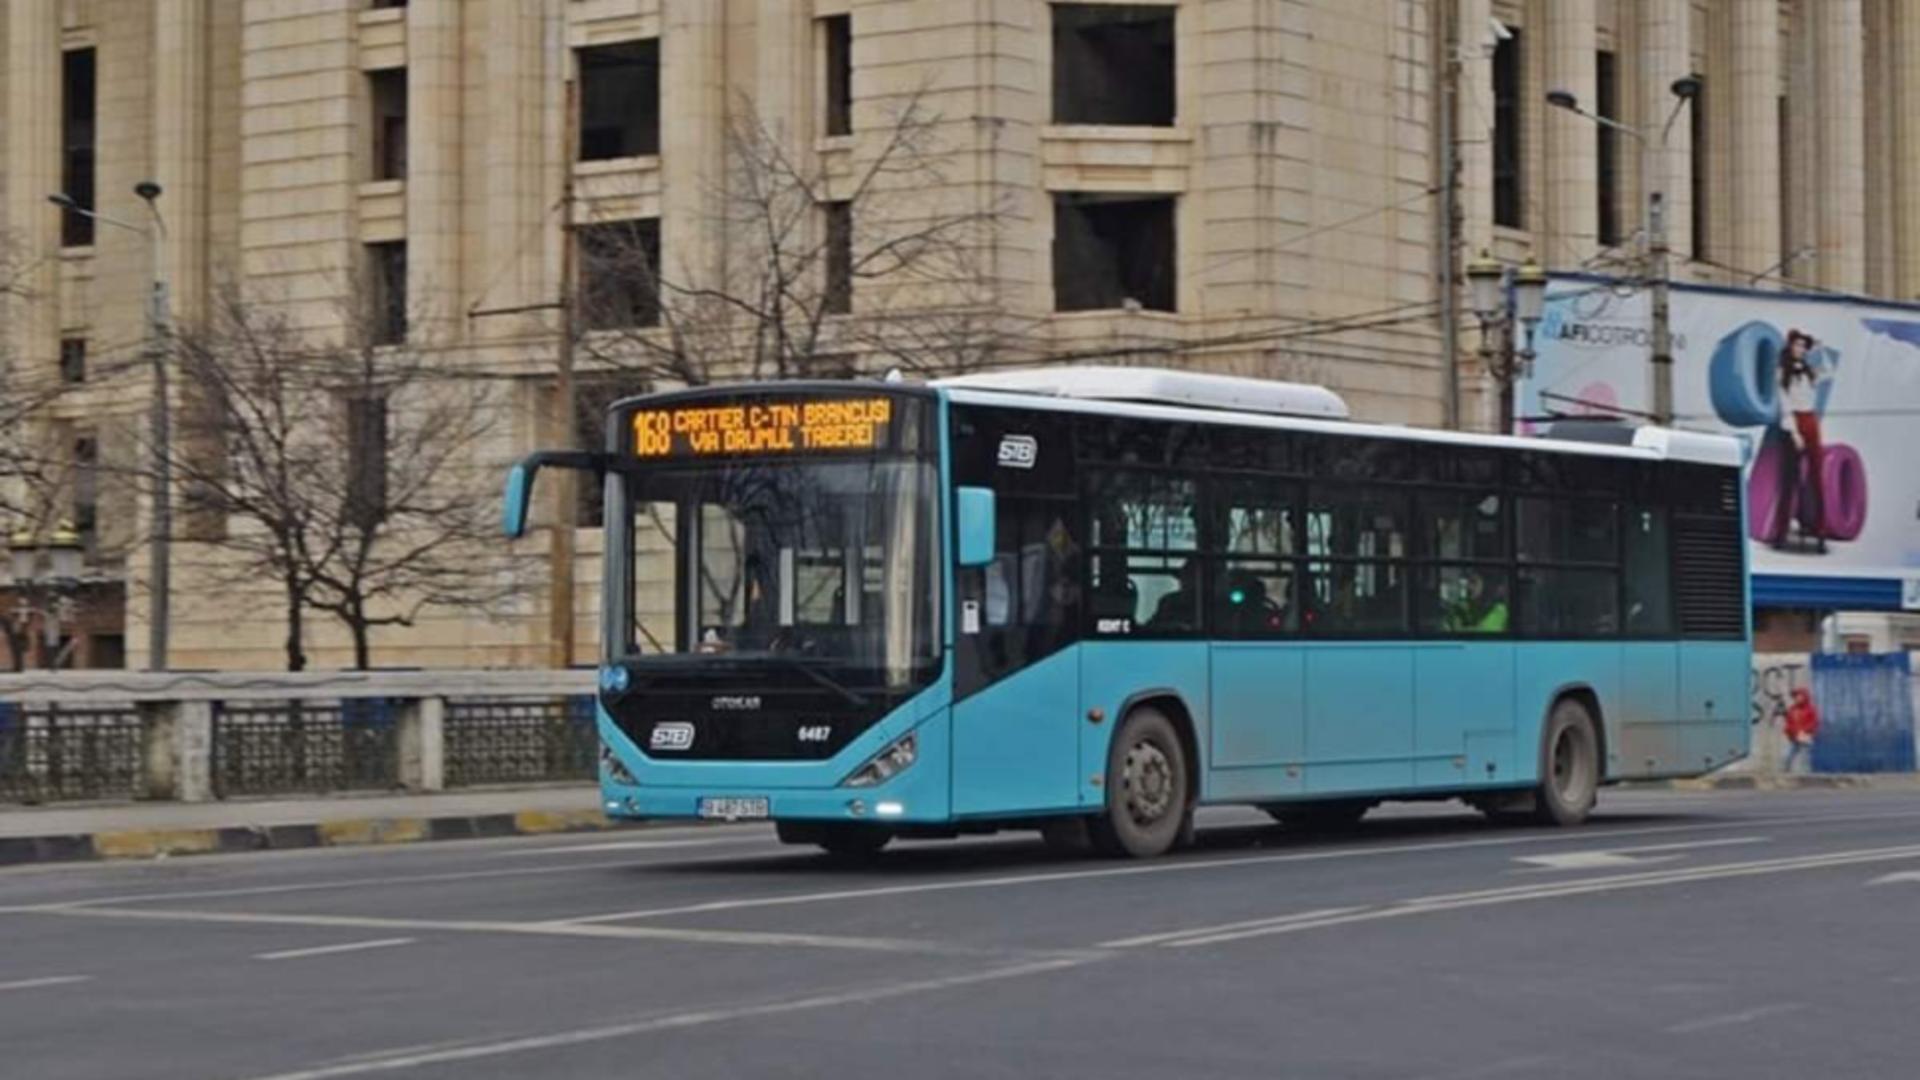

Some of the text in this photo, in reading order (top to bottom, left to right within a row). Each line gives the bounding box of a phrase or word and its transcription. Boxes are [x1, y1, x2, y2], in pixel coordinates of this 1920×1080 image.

[674, 398, 890, 432] CARTIER C-TIN BRANCUSI
[633, 410, 671, 455] 168
[690, 422, 874, 452] VIA DRUMUL TABEREI
[998, 438, 1034, 464] STB
[711, 696, 762, 710] OTOKAR
[650, 728, 692, 746] STB
[797, 725, 831, 742] 6487
